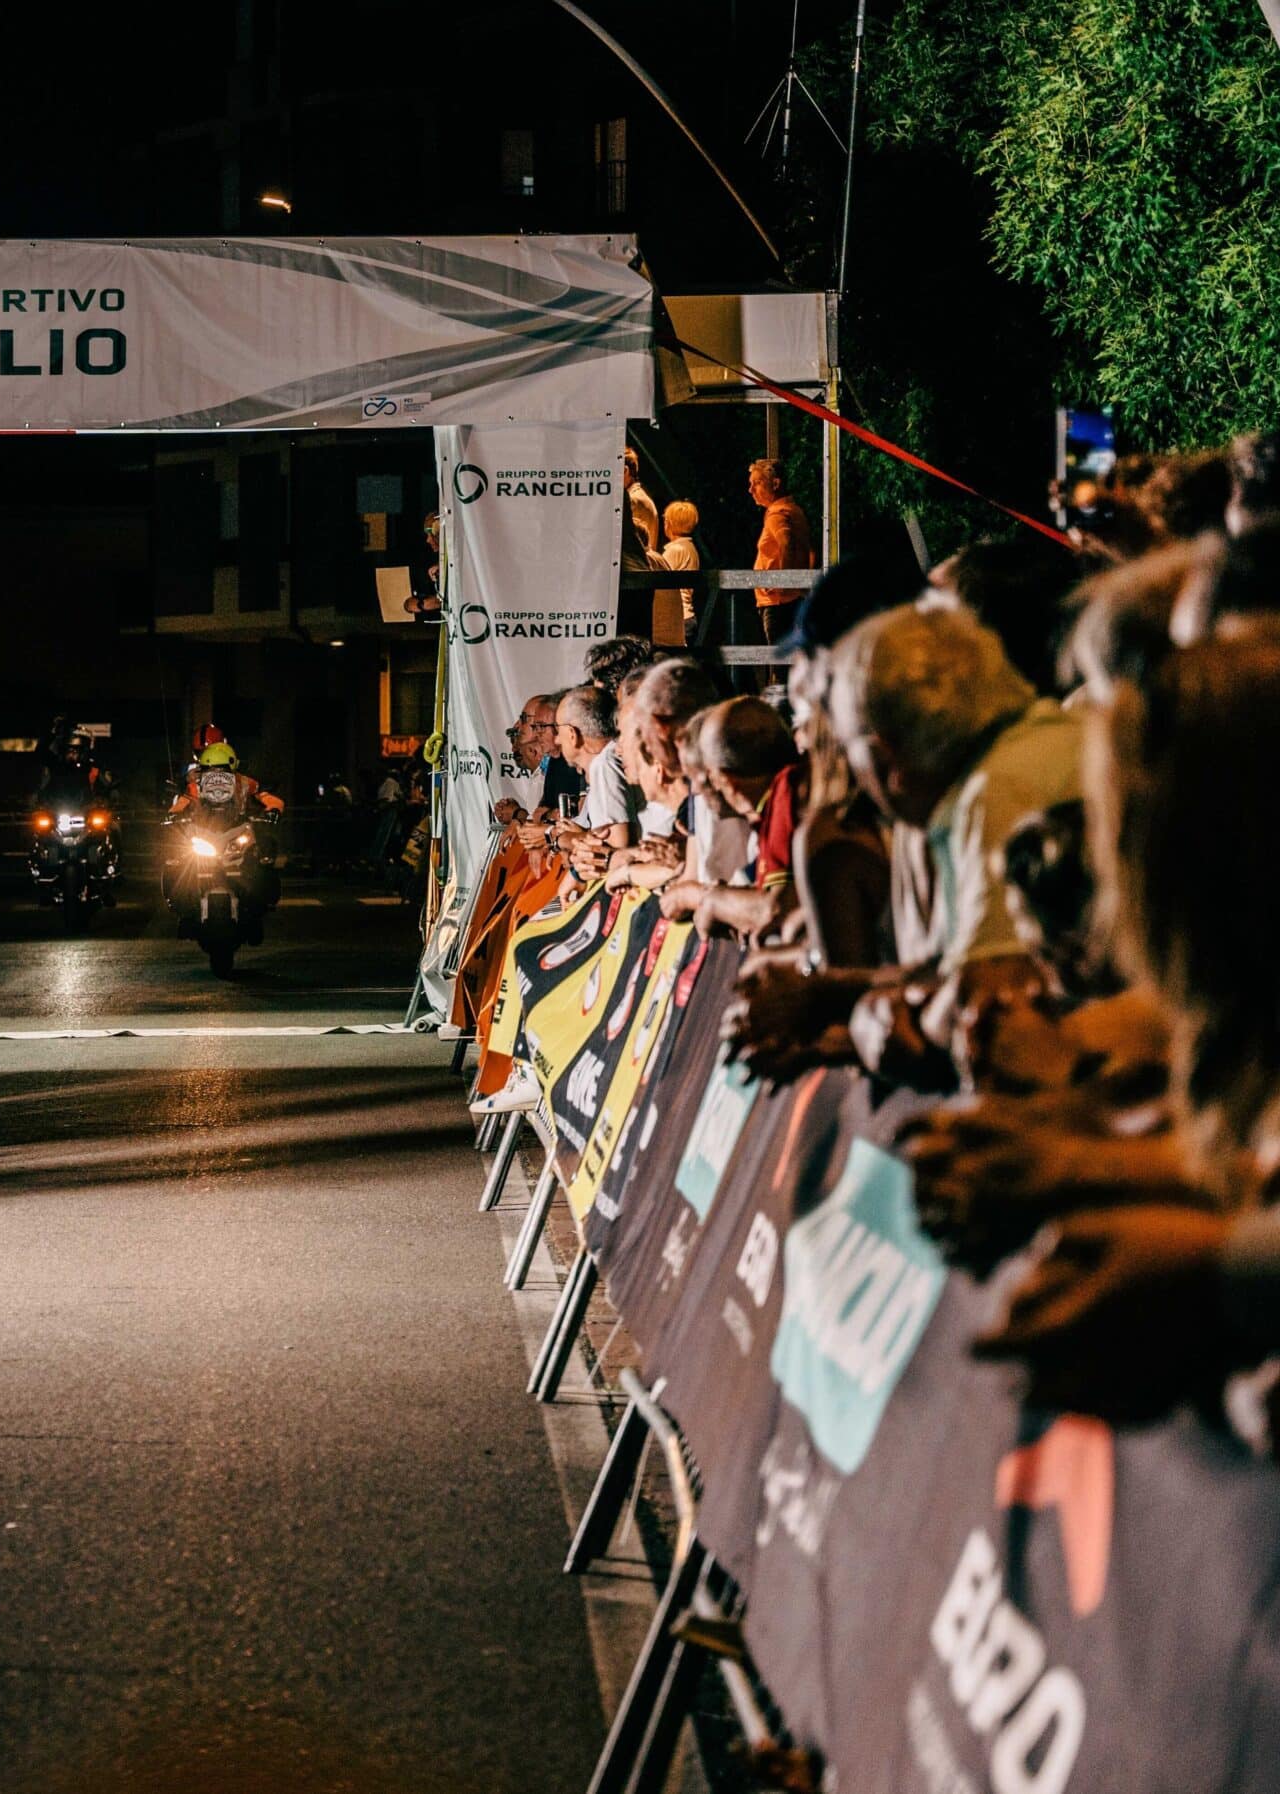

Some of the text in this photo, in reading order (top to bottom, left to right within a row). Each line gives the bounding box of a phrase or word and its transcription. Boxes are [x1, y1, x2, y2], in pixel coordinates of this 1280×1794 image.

[496, 470, 611, 479] GRUPPO SPORTIVO
[496, 481, 611, 497] RANCILIO
[494, 611, 607, 620] GRUPPO SPORTIVO
[495, 623, 607, 638] RANCILIO
